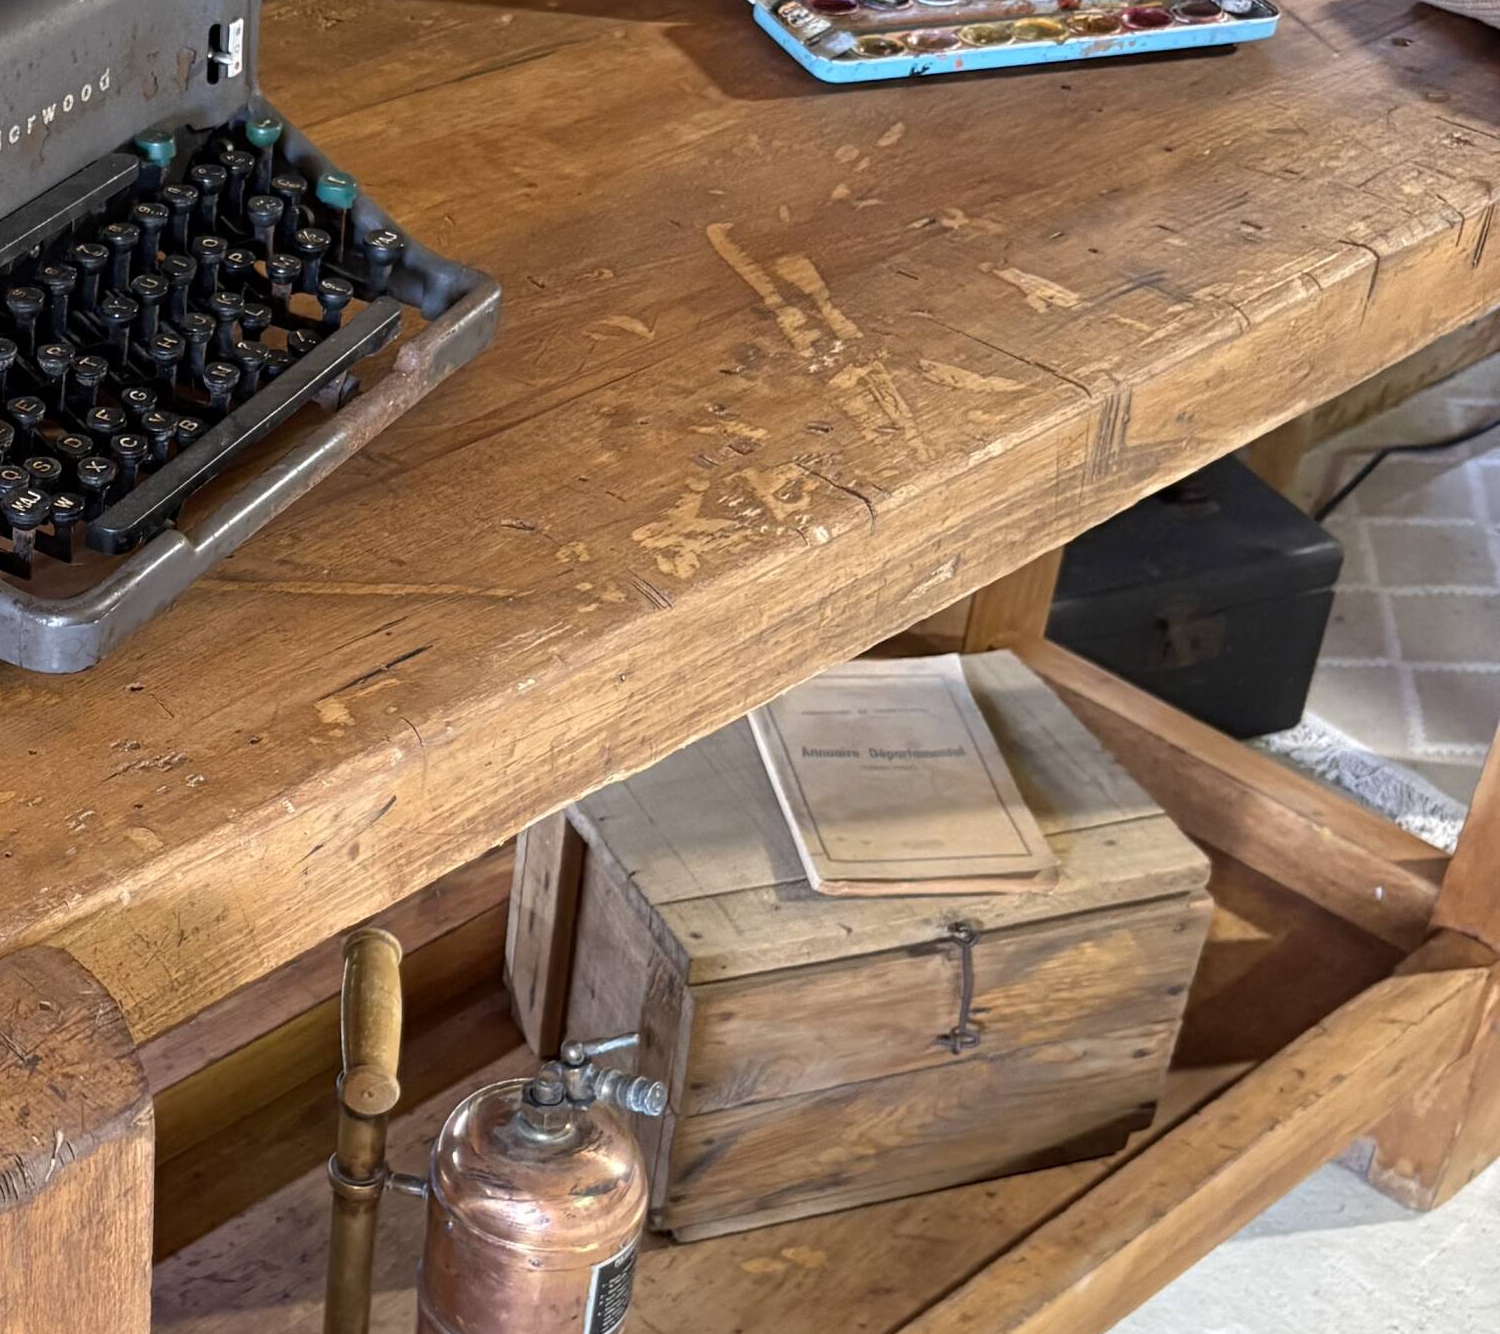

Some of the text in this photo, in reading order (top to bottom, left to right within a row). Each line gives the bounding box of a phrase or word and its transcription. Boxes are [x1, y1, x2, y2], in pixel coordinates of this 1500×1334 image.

[1, 470, 22, 481] Q
[32, 461, 52, 472] S
[63, 437, 82, 448] D
[95, 409, 111, 421] F
[129, 390, 148, 401] G
[157, 337, 178, 349] H
[216, 293, 237, 305] K
[245, 309, 265, 317] L
[15, 399, 37, 412] E
[79, 357, 98, 367] T
[140, 278, 159, 288] U
[202, 238, 219, 248] O
[227, 252, 244, 263] P
[11, 490, 42, 512] MAJ
[54, 496, 75, 509] W
[84, 460, 108, 473] X
[119, 437, 138, 448] C
[148, 412, 166, 423] V
[178, 419, 198, 432] B
[802, 745, 966, 761] Annuaire Départemental
